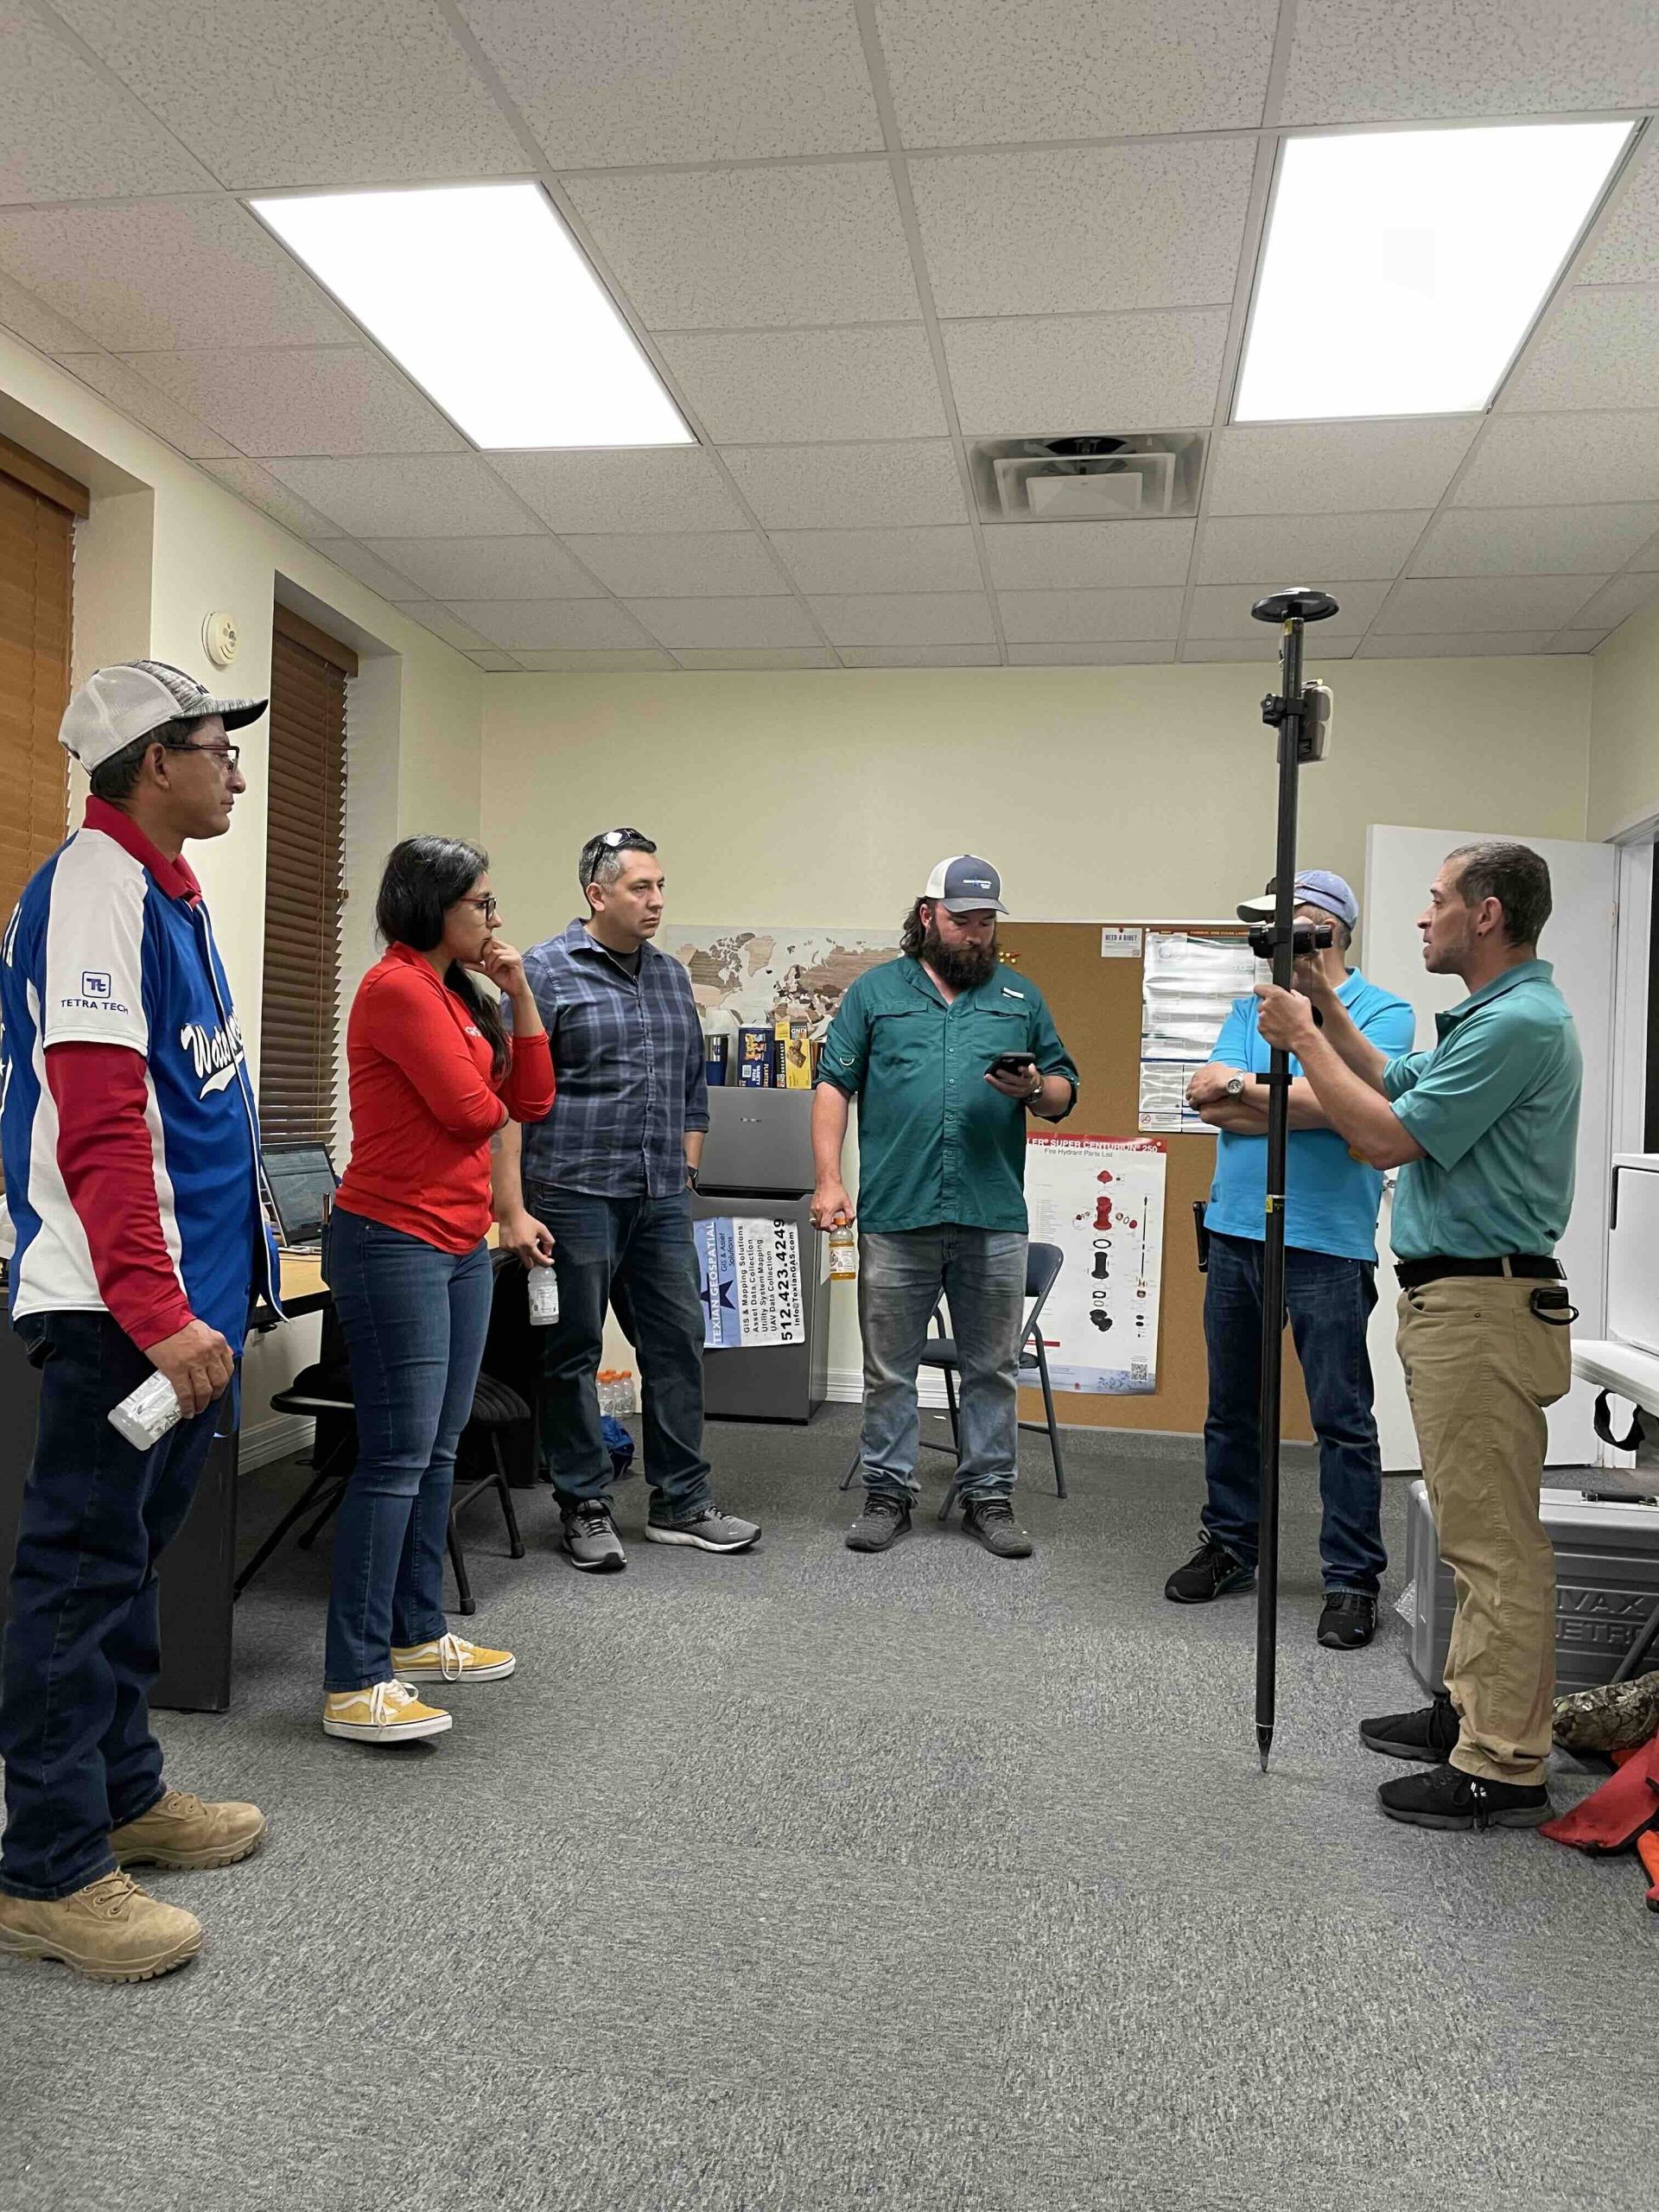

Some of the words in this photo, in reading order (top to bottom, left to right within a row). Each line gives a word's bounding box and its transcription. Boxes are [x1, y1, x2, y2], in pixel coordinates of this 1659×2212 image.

[60, 999, 98, 1009] TETRA
[102, 1001, 129, 1014] TECH
[1050, 1139, 1081, 1148] SUPER
[1142, 1145, 1158, 1154] 250
[706, 1222, 719, 1296] GEOSPATIAL
[737, 1225, 746, 1267] Solutions
[747, 1239, 756, 1283] Collection
[741, 1269, 749, 1306] Mapping
[759, 1276, 767, 1306] System
[766, 1250, 774, 1292] Collection
[773, 1218, 793, 1340] 512.423.4249
[711, 1300, 722, 1343] TEXIAN
[760, 1308, 769, 1332] Utility
